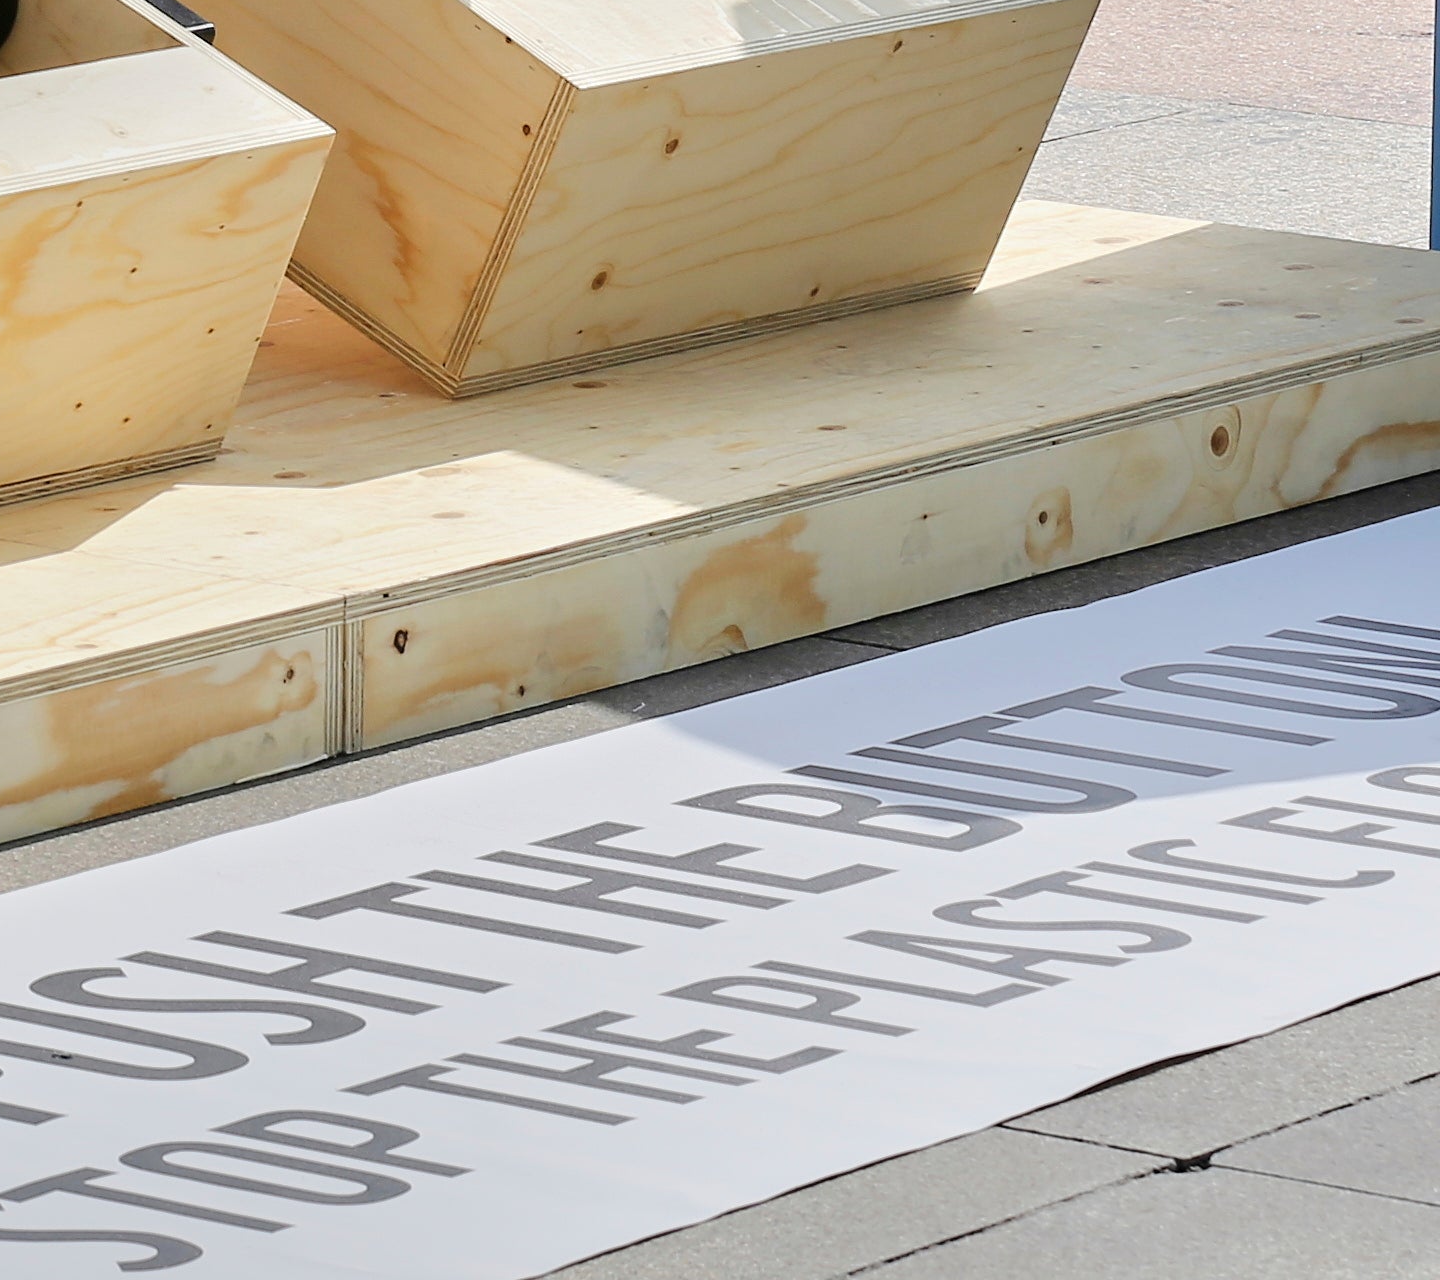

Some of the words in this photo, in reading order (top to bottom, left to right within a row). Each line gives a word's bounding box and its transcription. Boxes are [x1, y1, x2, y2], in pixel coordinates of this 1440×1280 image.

[281, 820, 900, 954] THE
[338, 1009, 845, 1126] THE
[659, 838, 1396, 1037] PLASTIC
